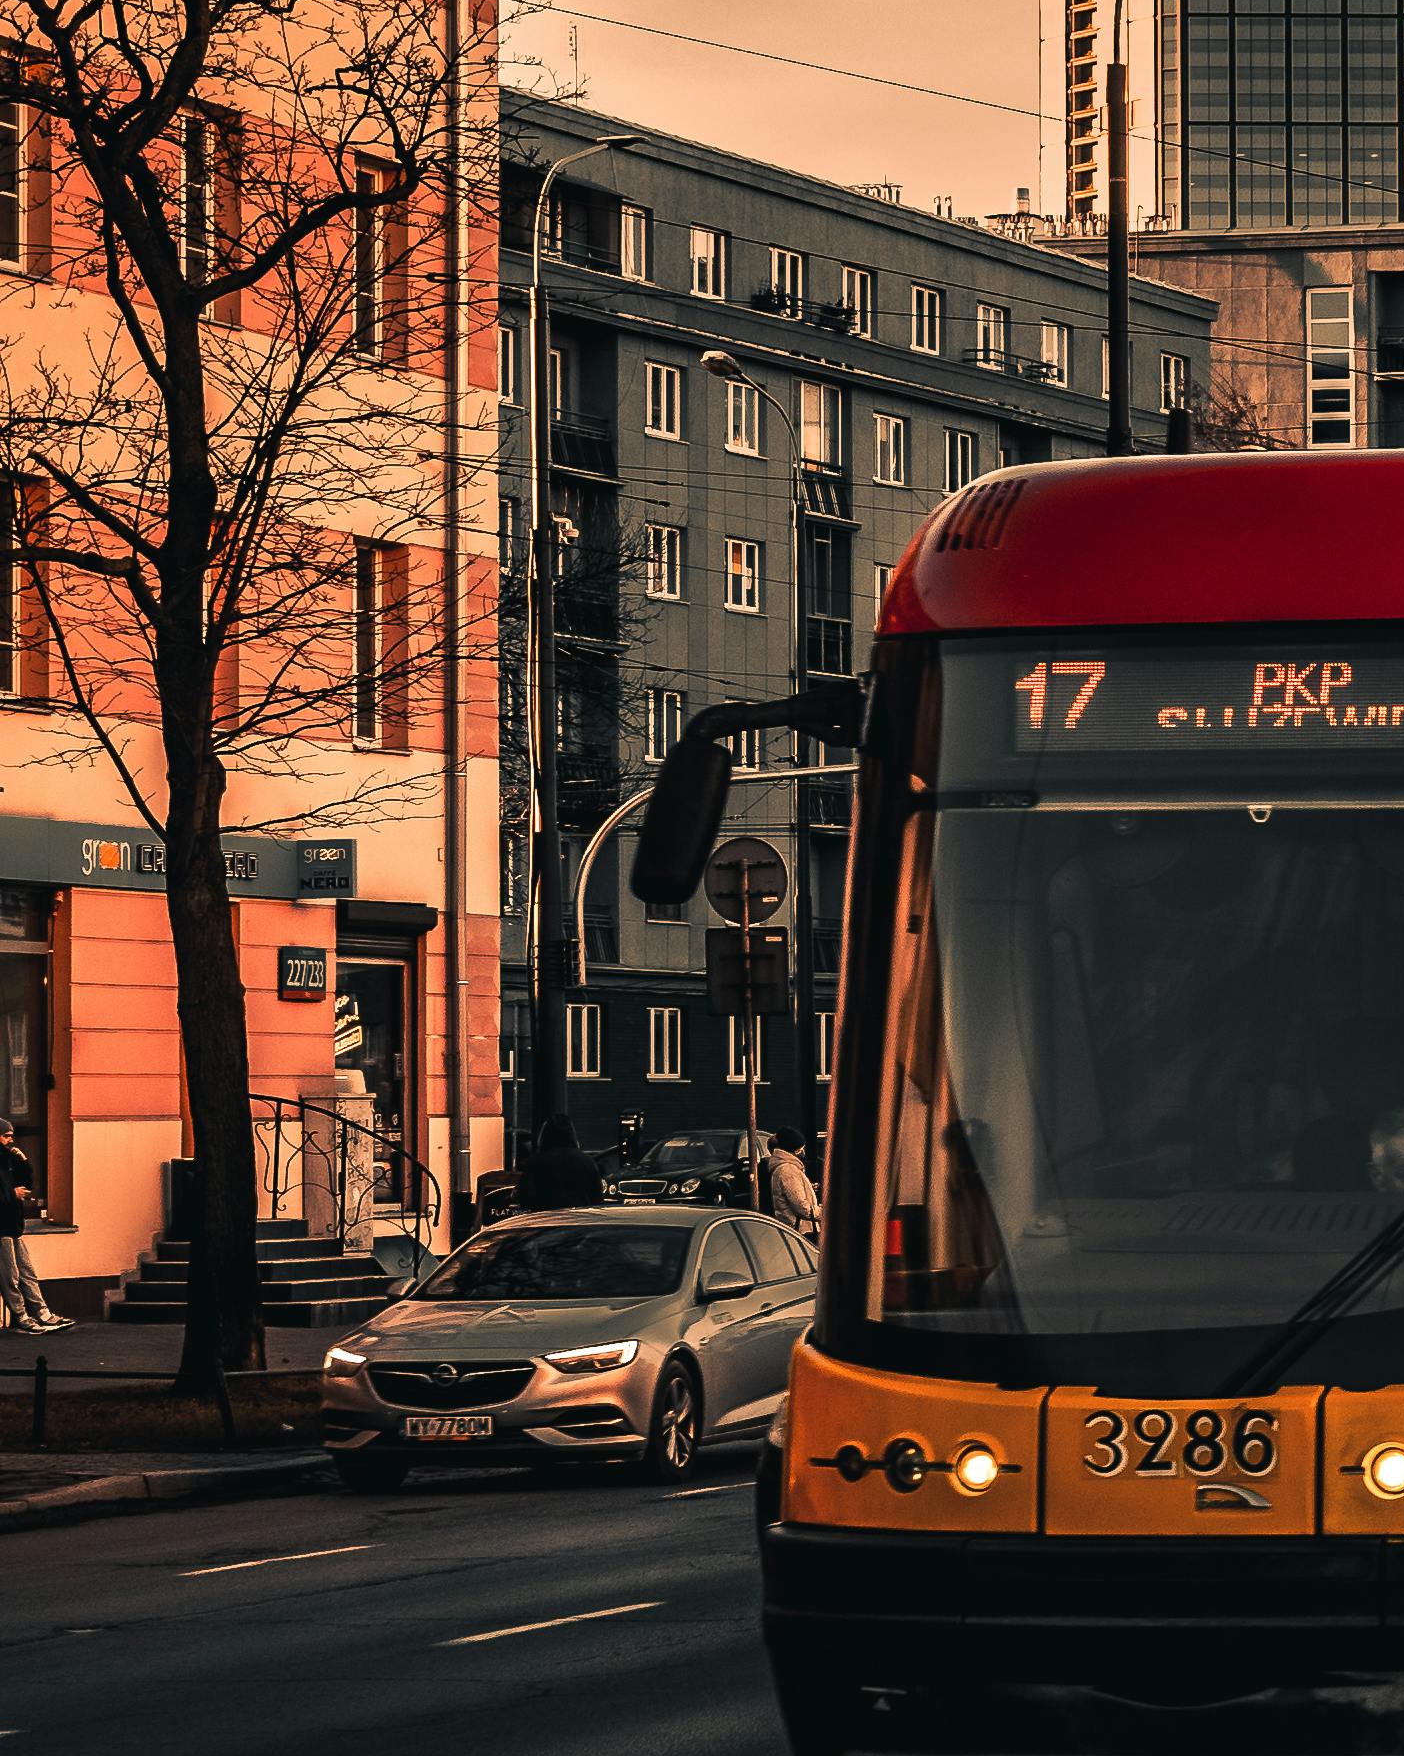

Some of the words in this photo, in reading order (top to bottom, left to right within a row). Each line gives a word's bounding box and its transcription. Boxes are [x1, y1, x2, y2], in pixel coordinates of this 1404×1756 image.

[1014, 660, 1107, 730] 17
[1252, 661, 1354, 707] PKP
[1083, 1409, 1279, 1478] 3286
